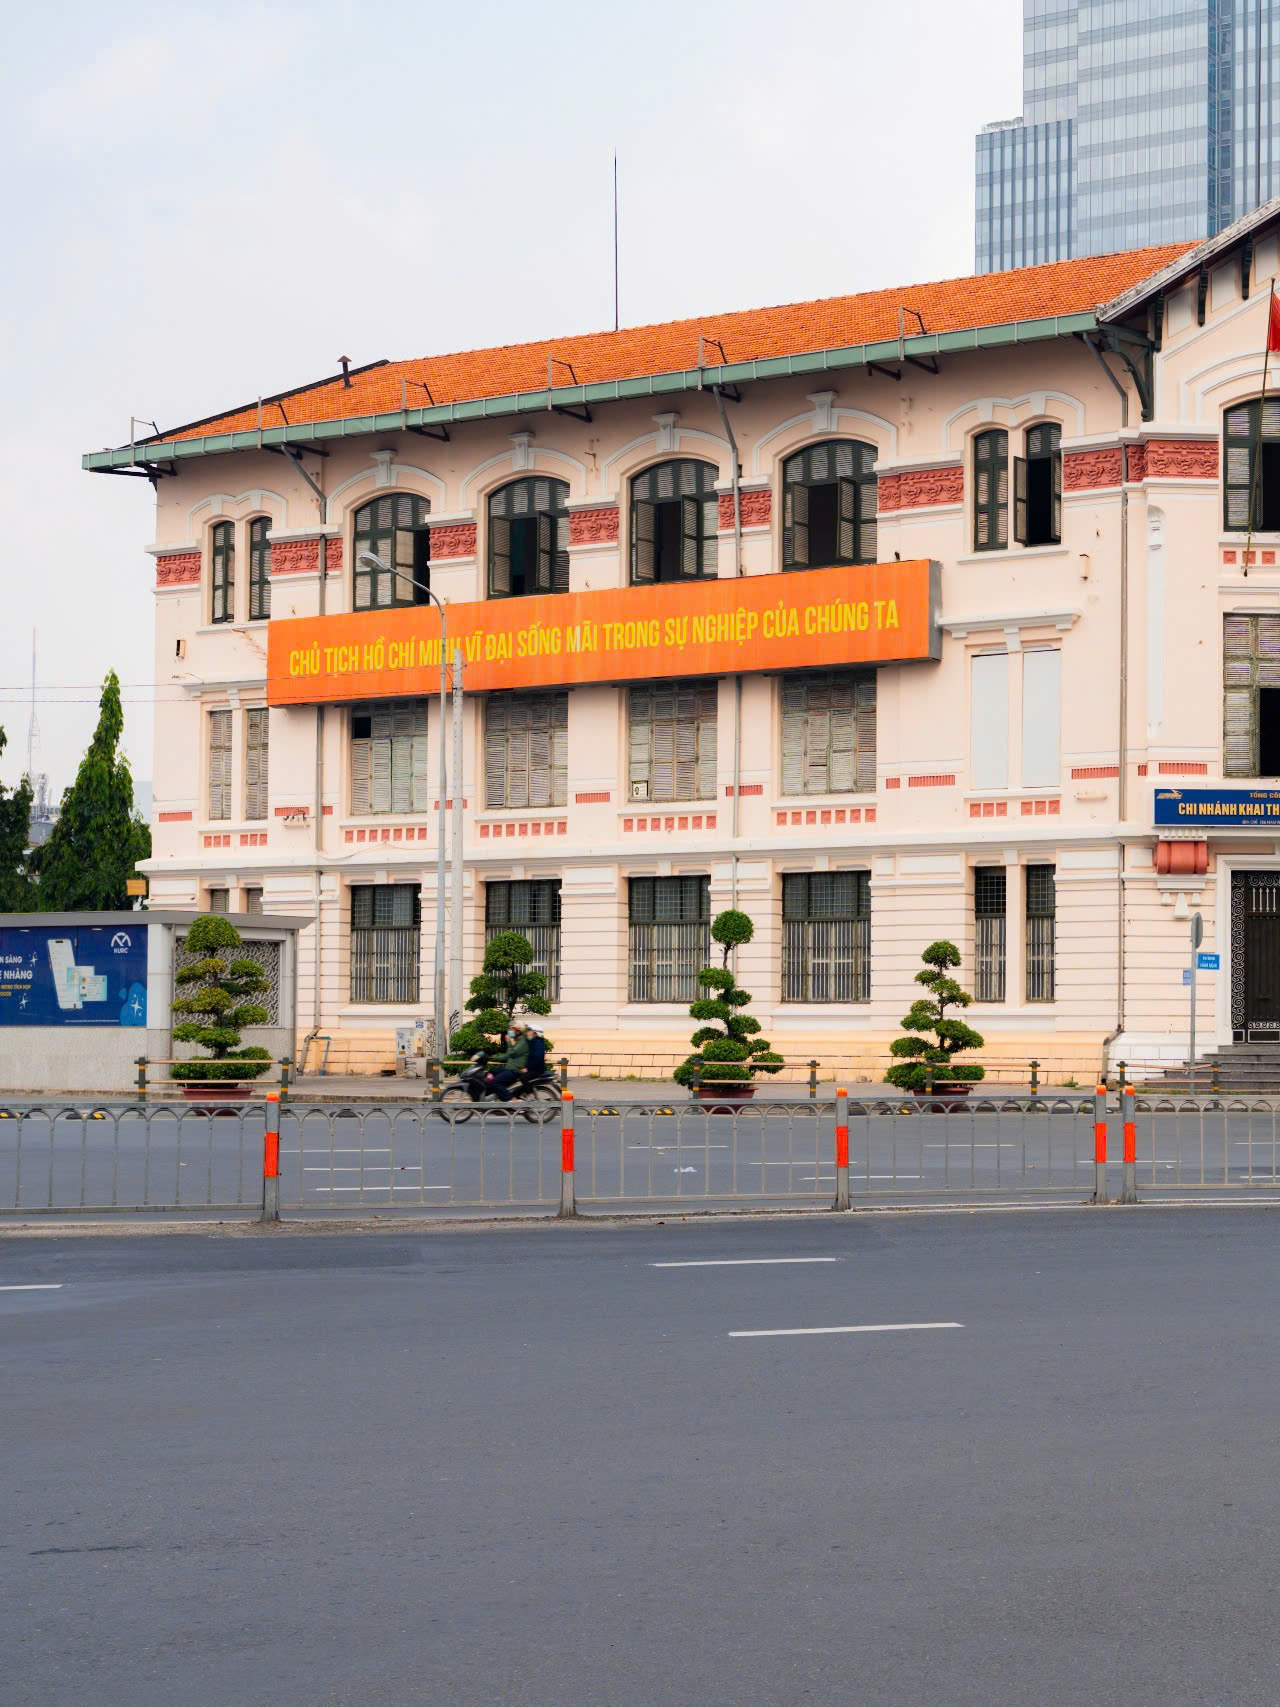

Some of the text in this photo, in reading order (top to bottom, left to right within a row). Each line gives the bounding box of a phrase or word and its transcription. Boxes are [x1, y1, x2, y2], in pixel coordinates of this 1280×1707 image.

[289, 640, 320, 677] CHỦ
[324, 645, 359, 678] TỊCH
[363, 635, 385, 671] HỒ
[388, 636, 416, 669] CHÍ
[465, 630, 483, 662] VĨ
[485, 631, 513, 664] ĐẠI
[517, 621, 562, 657] SỐNG
[566, 620, 598, 653] MÃI
[602, 619, 660, 650] TRONG
[664, 615, 689, 650] SỰ
[692, 606, 759, 646] NGHIỆP
[763, 600, 800, 638] CỦA
[805, 598, 869, 635] CHÚNG
[873, 599, 900, 630] TA
[1178, 802, 1197, 815] CHI
[1198, 801, 1237, 815] NHÁNH
[1239, 803, 1265, 815] KHAI
[4, 967, 33, 979] NHÀNG
